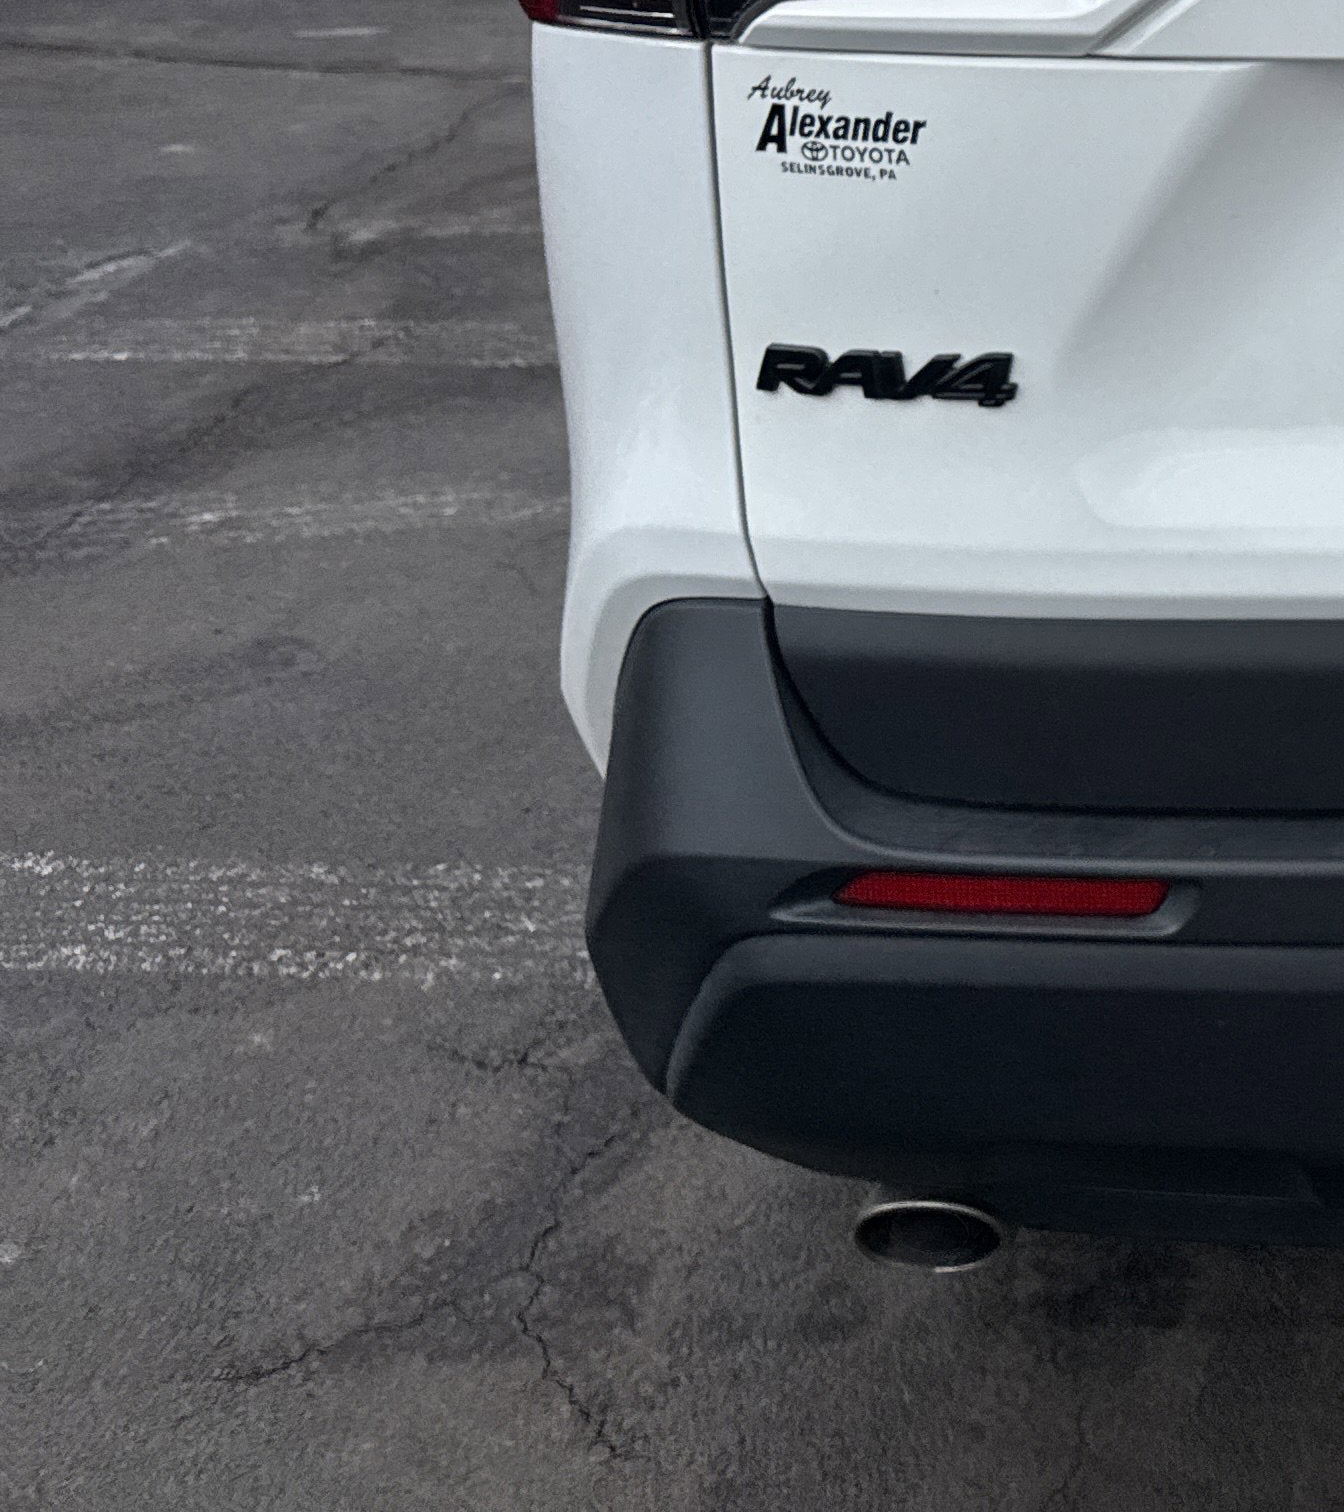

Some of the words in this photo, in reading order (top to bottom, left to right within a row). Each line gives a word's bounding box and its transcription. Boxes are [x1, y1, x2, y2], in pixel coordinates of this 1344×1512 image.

[748, 74, 832, 109] Aubrey
[755, 103, 927, 154] Alexander
[781, 161, 876, 181] SELINSGROVE,
[879, 168, 897, 180] PA
[829, 144, 910, 166] TOYOTA
[756, 342, 1018, 408] RAV4
